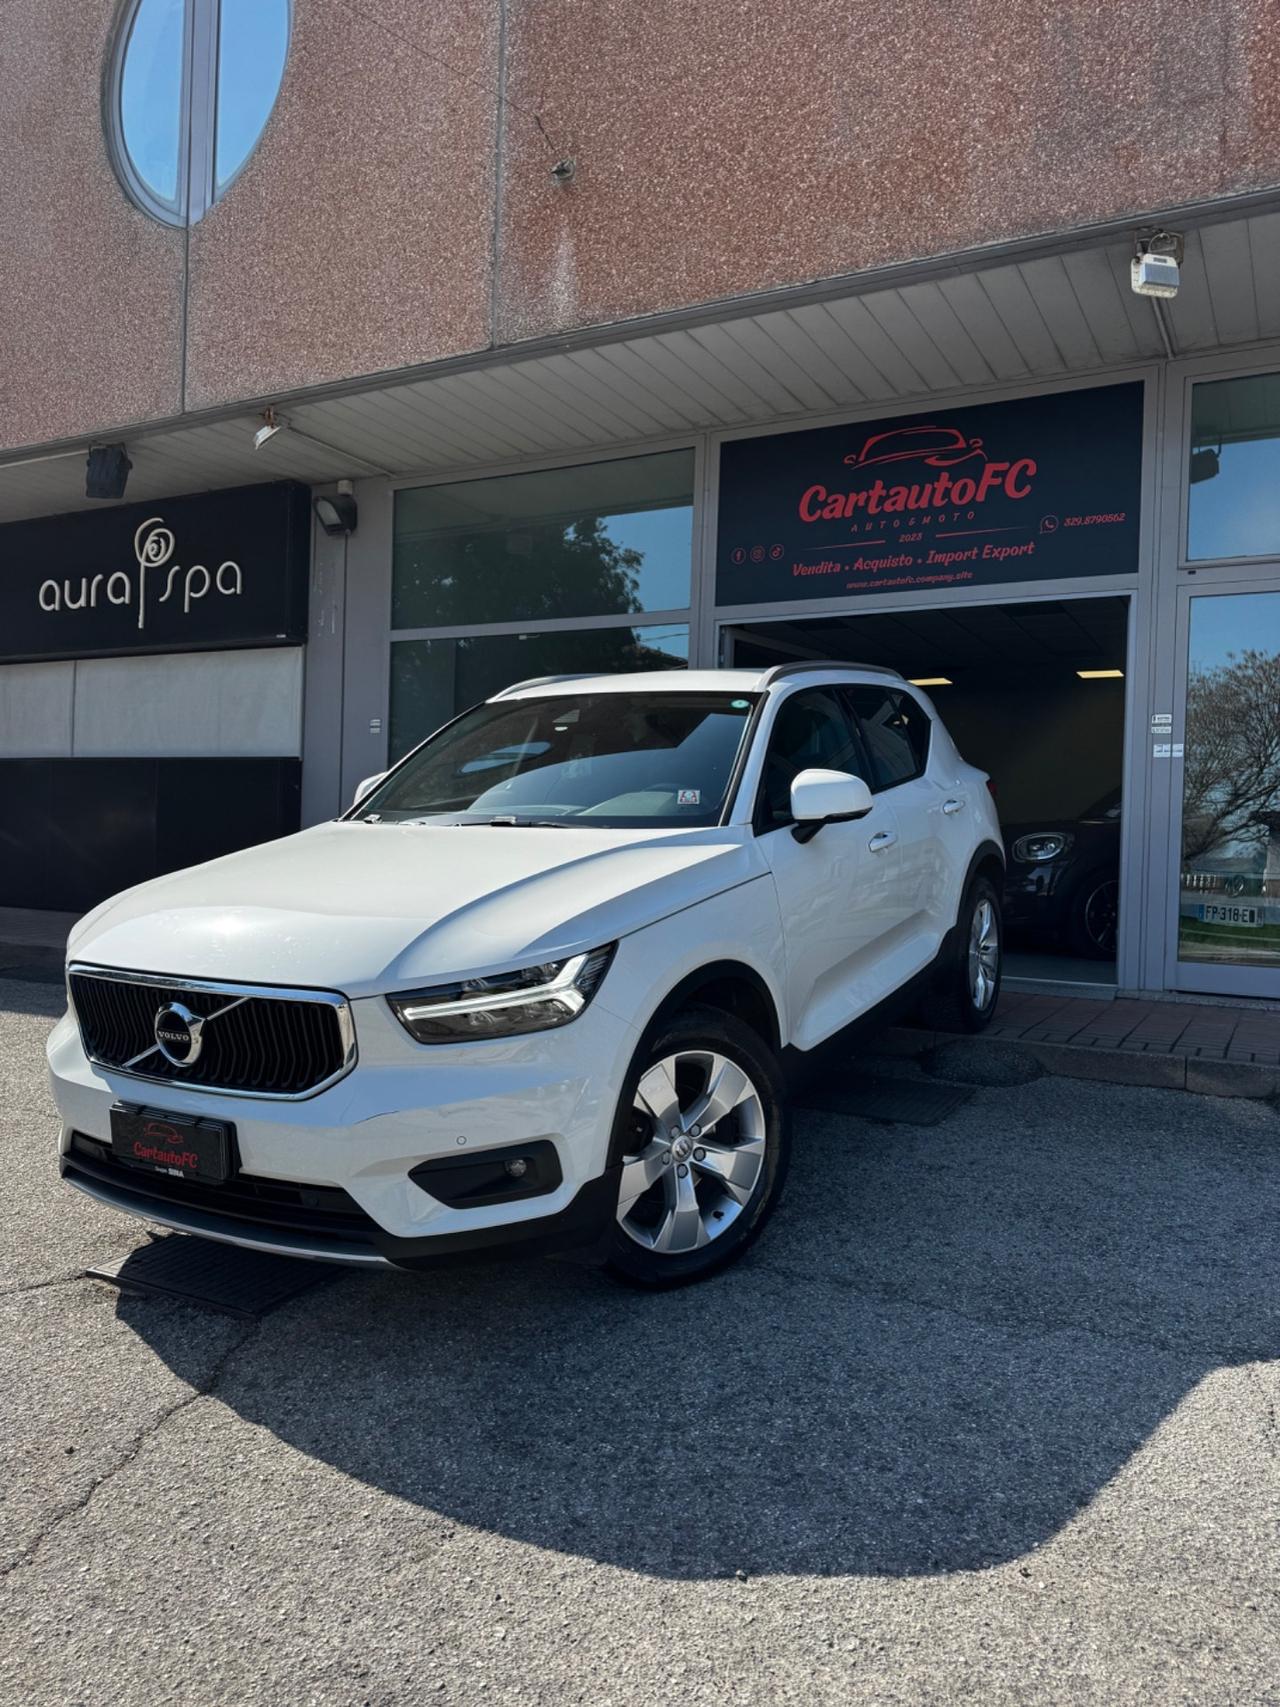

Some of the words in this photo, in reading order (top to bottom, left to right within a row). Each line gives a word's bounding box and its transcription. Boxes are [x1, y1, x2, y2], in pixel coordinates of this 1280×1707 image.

[799, 458, 1037, 522] CartautoFC
[898, 532, 923, 543] 2023
[792, 560, 841, 576] Vendita
[853, 553, 913, 573] Acquisto
[926, 546, 978, 566] Import
[982, 541, 1035, 561] Export
[38, 571, 131, 611] aura
[158, 561, 242, 613] spa
[158, 1031, 190, 1041] VOLVO
[133, 1141, 199, 1169] CartautoFC
